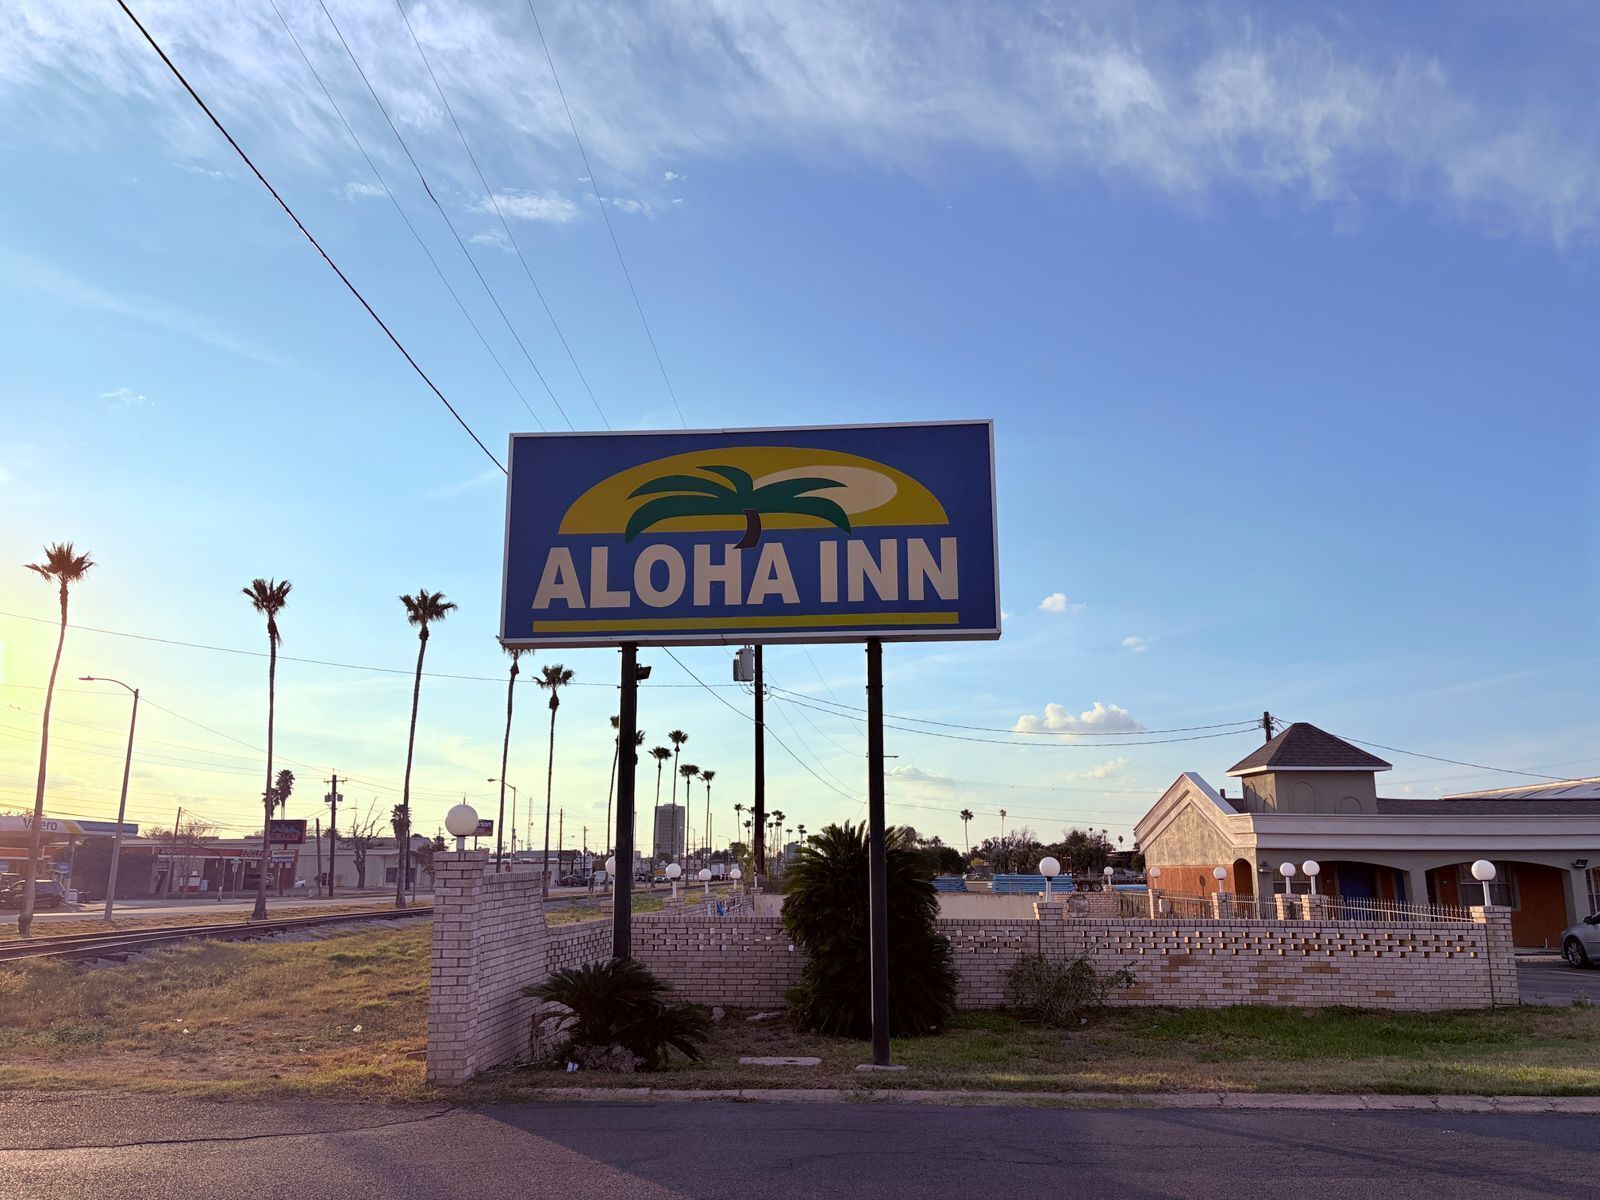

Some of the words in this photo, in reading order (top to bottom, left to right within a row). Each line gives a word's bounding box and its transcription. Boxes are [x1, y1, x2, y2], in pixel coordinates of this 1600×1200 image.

[531, 542, 801, 609] ALOHA
[819, 536, 959, 603] INN
[23, 817, 58, 831] Vero
